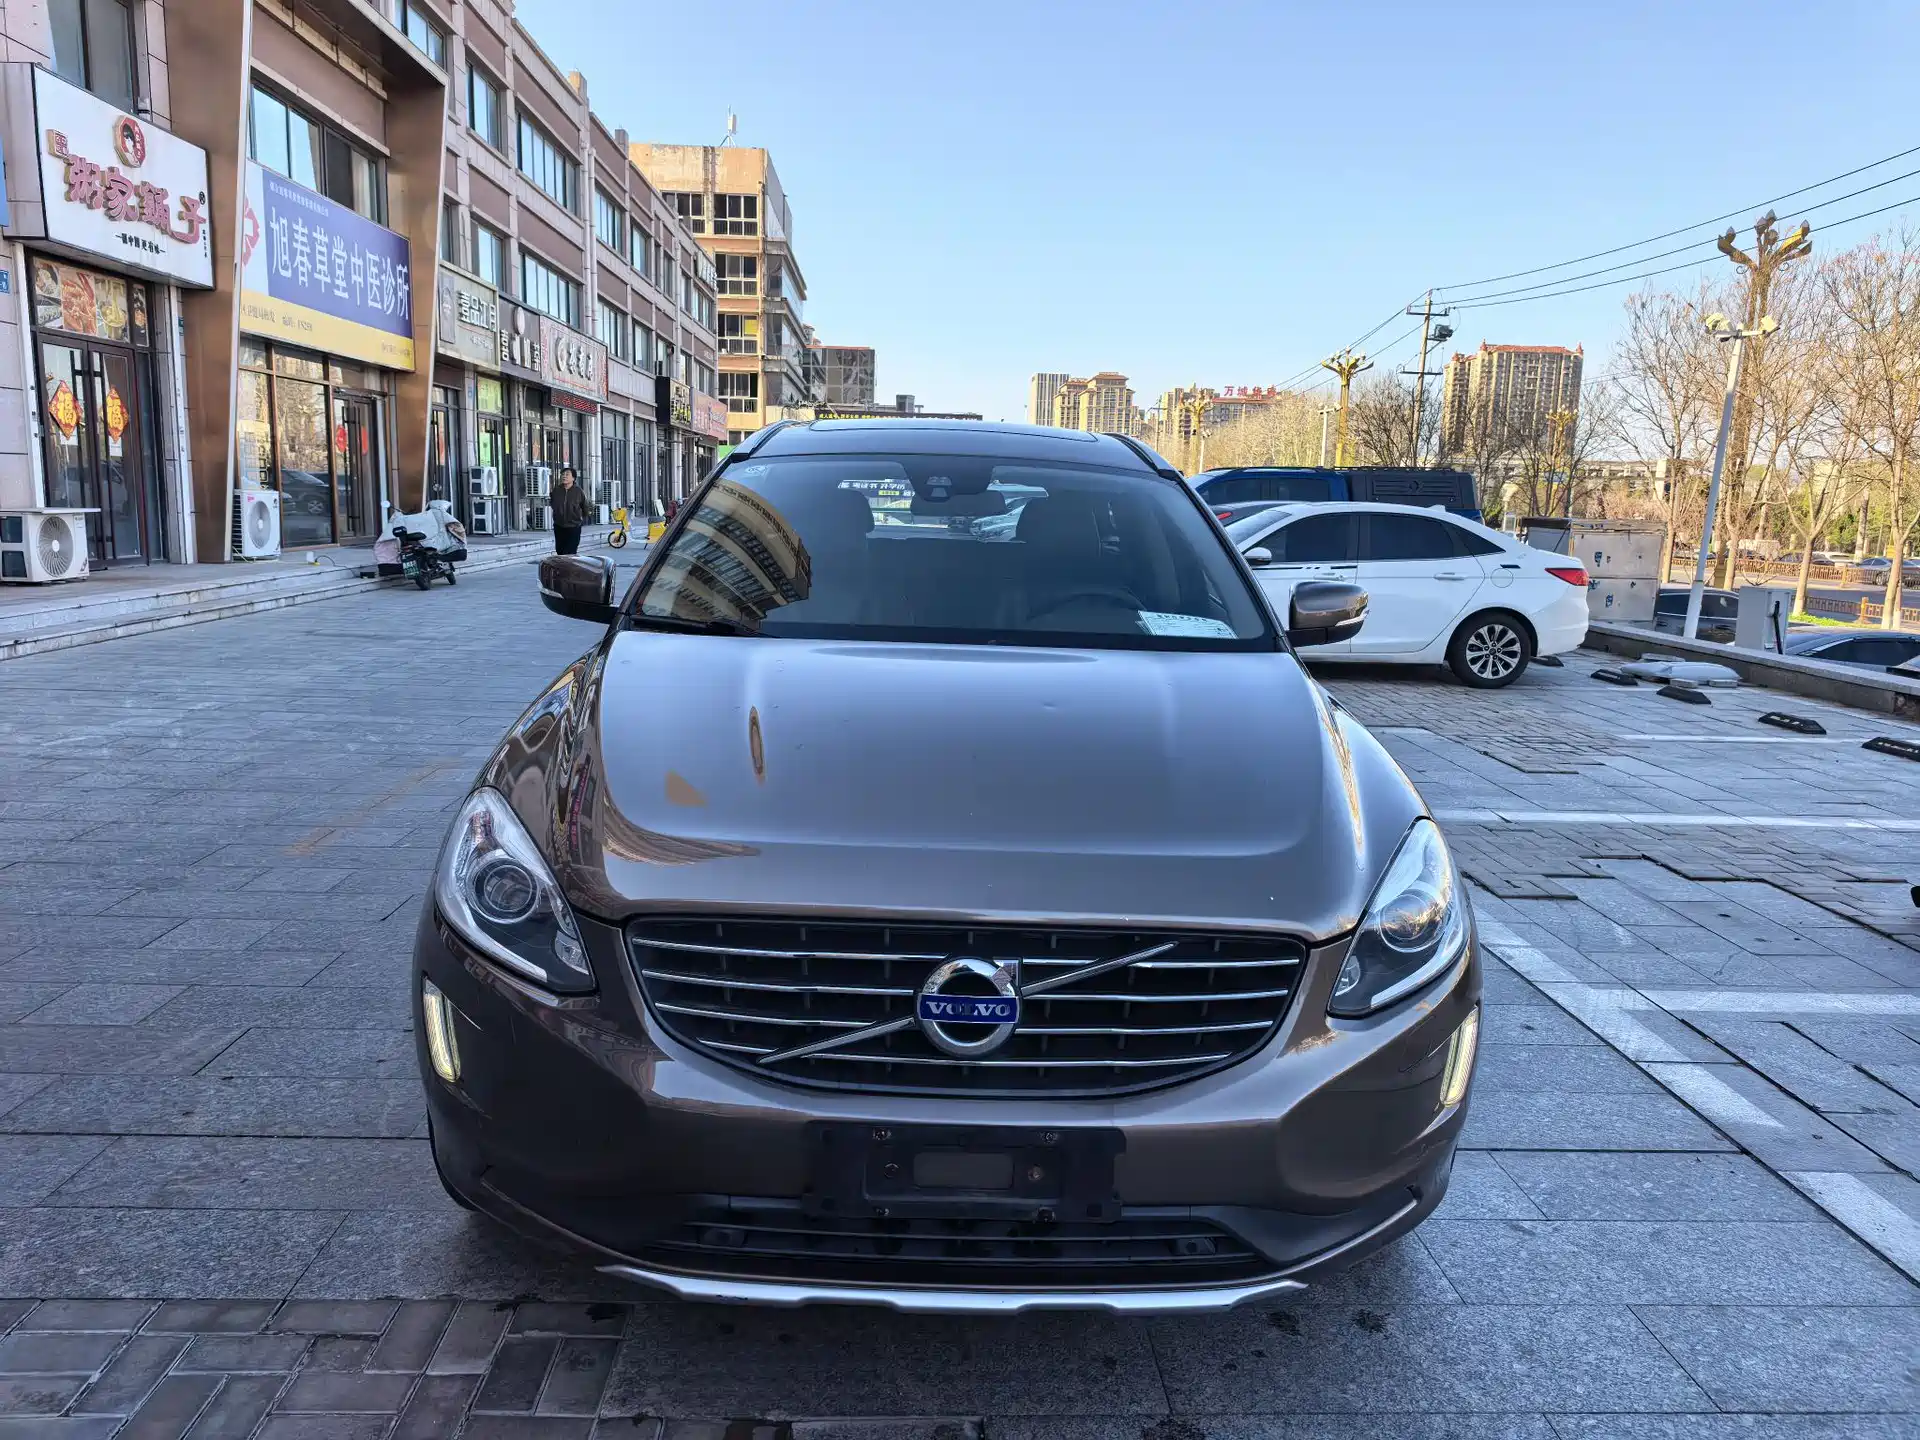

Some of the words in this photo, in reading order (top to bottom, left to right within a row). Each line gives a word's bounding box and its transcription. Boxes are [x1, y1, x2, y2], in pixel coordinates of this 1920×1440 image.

[269, 206, 410, 320] 旭春草堂中医诊所
[57, 390, 77, 427] 福
[105, 395, 124, 432] 福
